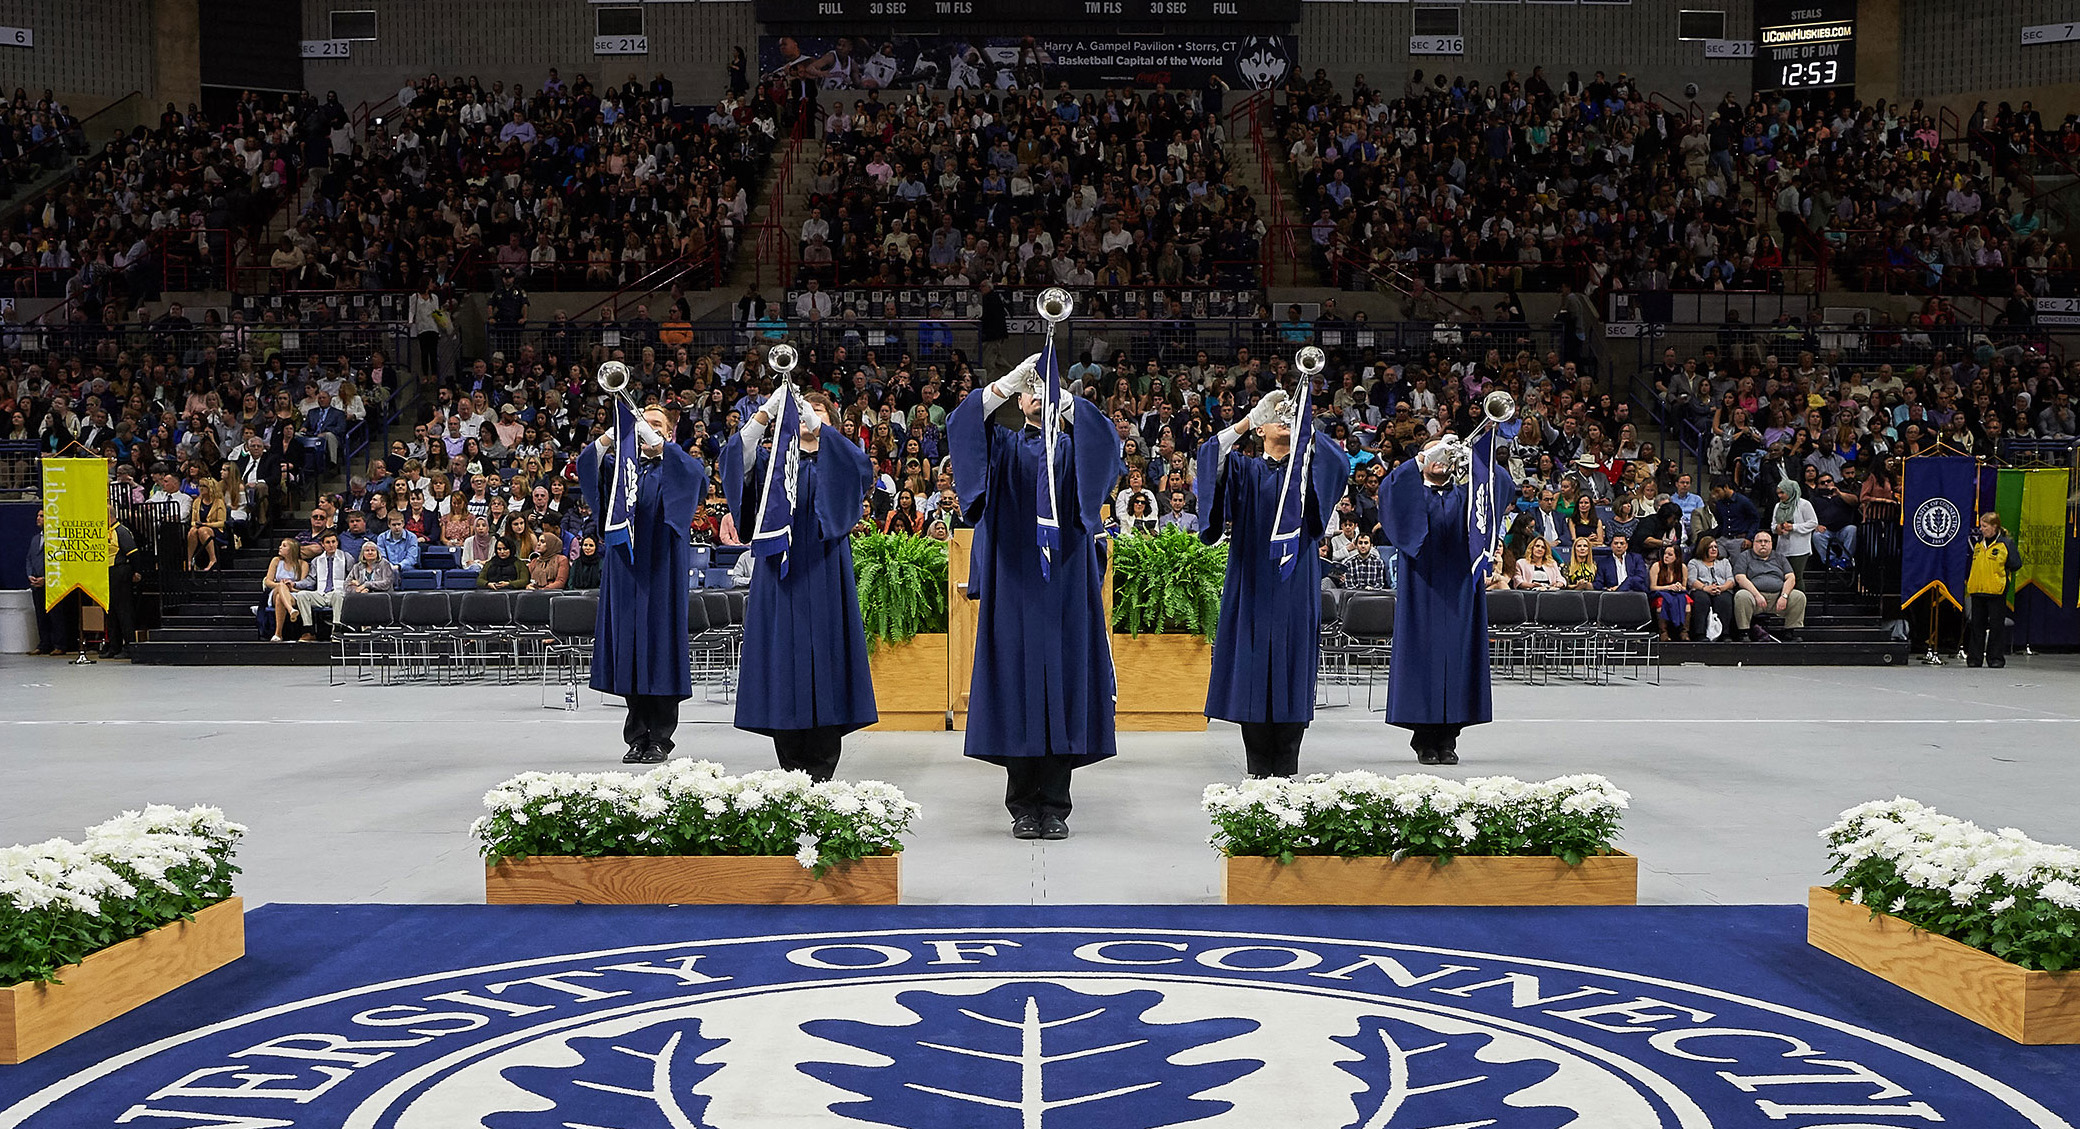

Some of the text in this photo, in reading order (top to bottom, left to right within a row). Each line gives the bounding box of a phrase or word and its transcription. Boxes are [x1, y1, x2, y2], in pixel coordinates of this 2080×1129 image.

[818, 2, 844, 14] FULL
[870, 2, 907, 14] 30 SEC
[935, 2, 972, 13] TM FLS
[1085, 2, 1122, 13] TM FLS
[1150, 2, 1187, 14] 30 SEC
[1213, 2, 1238, 14] FULL
[1791, 8, 1822, 20] STEALS
[15, 30, 25, 43] 6
[2023, 25, 2074, 40] SEC 7
[323, 43, 348, 55] 213
[595, 39, 647, 51] SEC 214
[1044, 41, 1237, 54] Harry A. Gampel Pavilion Storrs, CT
[1411, 39, 1463, 51] SEC 216
[1732, 43, 1757, 55] 217
[1772, 44, 1840, 60] TIME OF DAY
[1058, 56, 1223, 68] Basketball Capital of the World
[1781, 60, 1838, 86] 12:53
[2038, 300, 2057, 309] SEC
[1607, 326, 1627, 335] SEC
[62, 520, 105, 528] COLLEGE OF
[57, 527, 105, 539] LIBERAL
[59, 539, 106, 551] ARTS AND
[47, 550, 105, 562] SCIENCES
[786, 939, 1022, 970] OF
